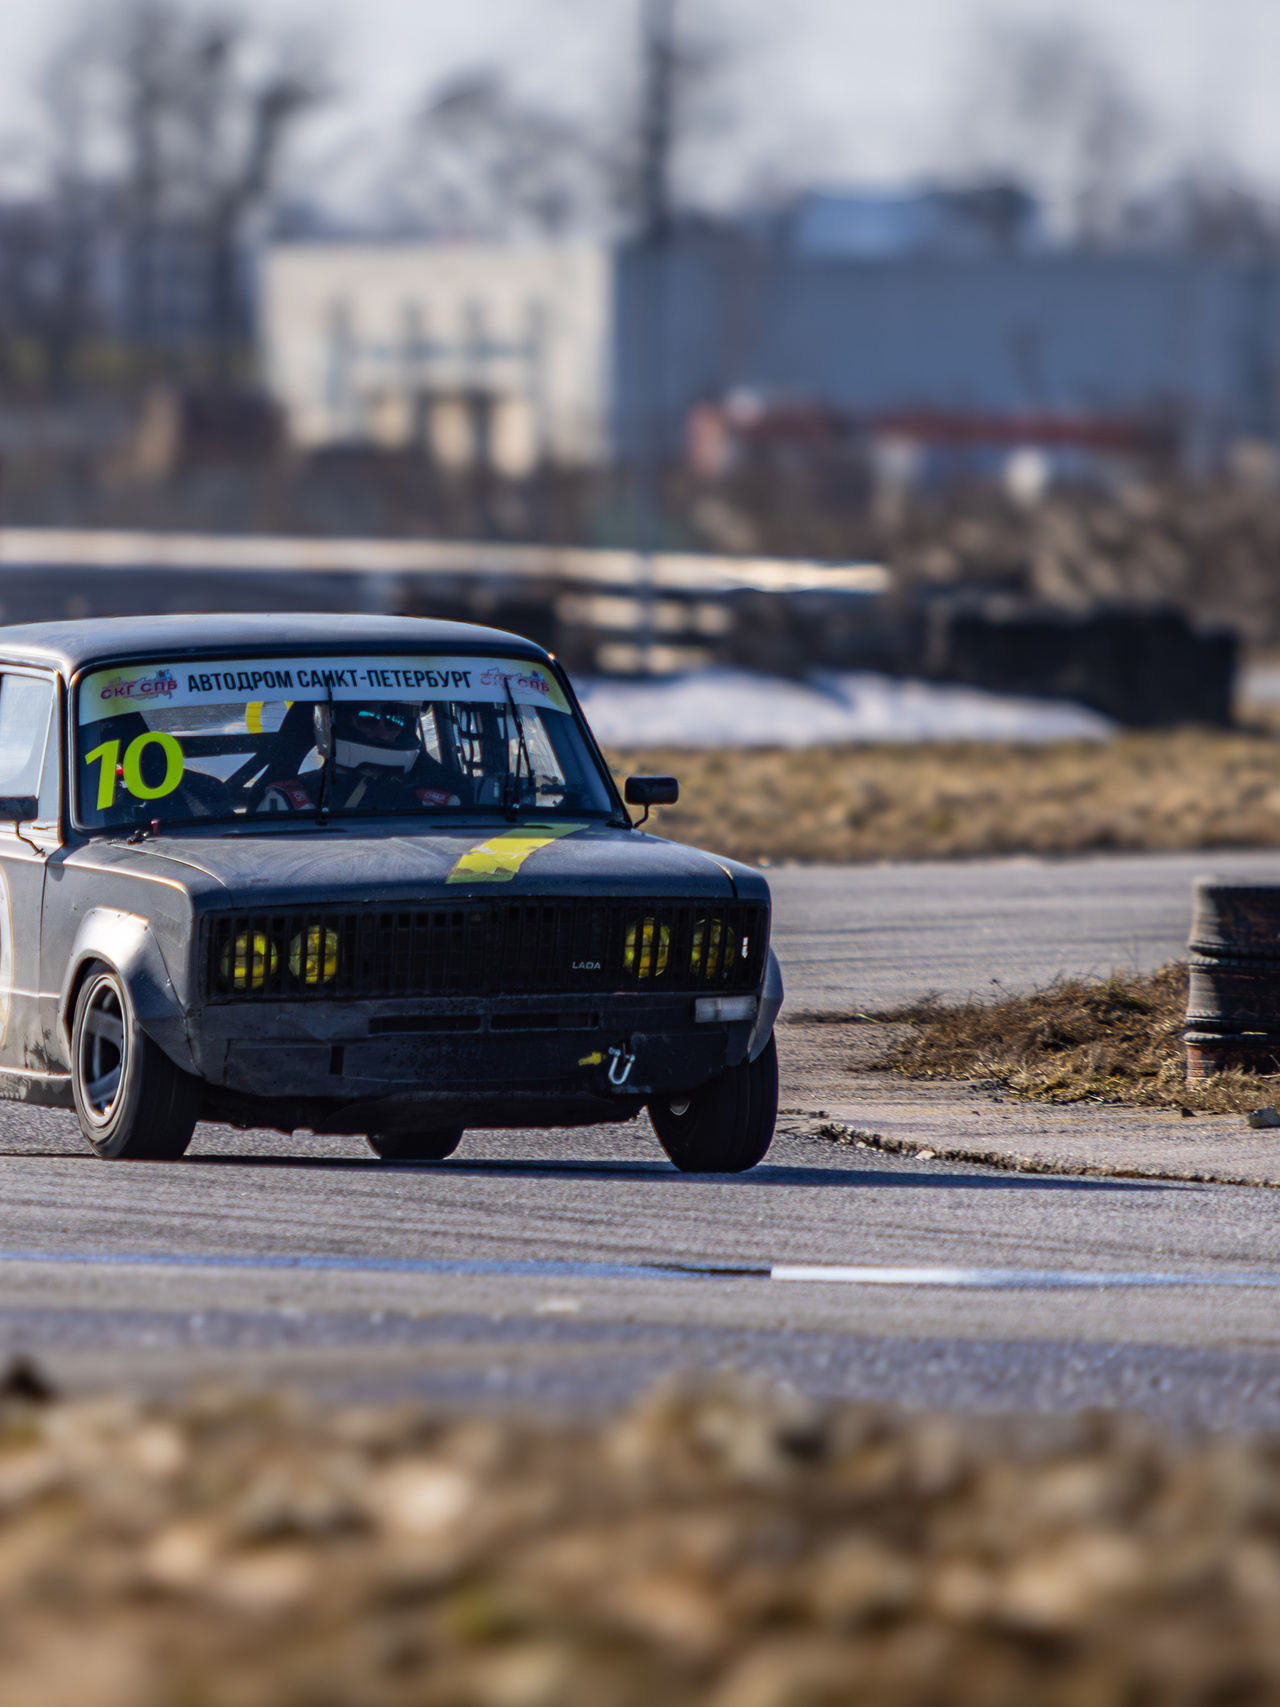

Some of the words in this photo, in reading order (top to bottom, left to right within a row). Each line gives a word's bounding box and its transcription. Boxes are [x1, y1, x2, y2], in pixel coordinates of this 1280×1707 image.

[101, 682, 134, 700] СКГ
[140, 680, 178, 695] СПБ
[187, 671, 293, 693] АВТОДРОМ
[297, 669, 472, 691] САНКТ-ПЕТЕРБУРГ
[84, 731, 184, 811] 10
[572, 961, 601, 970] LADA
